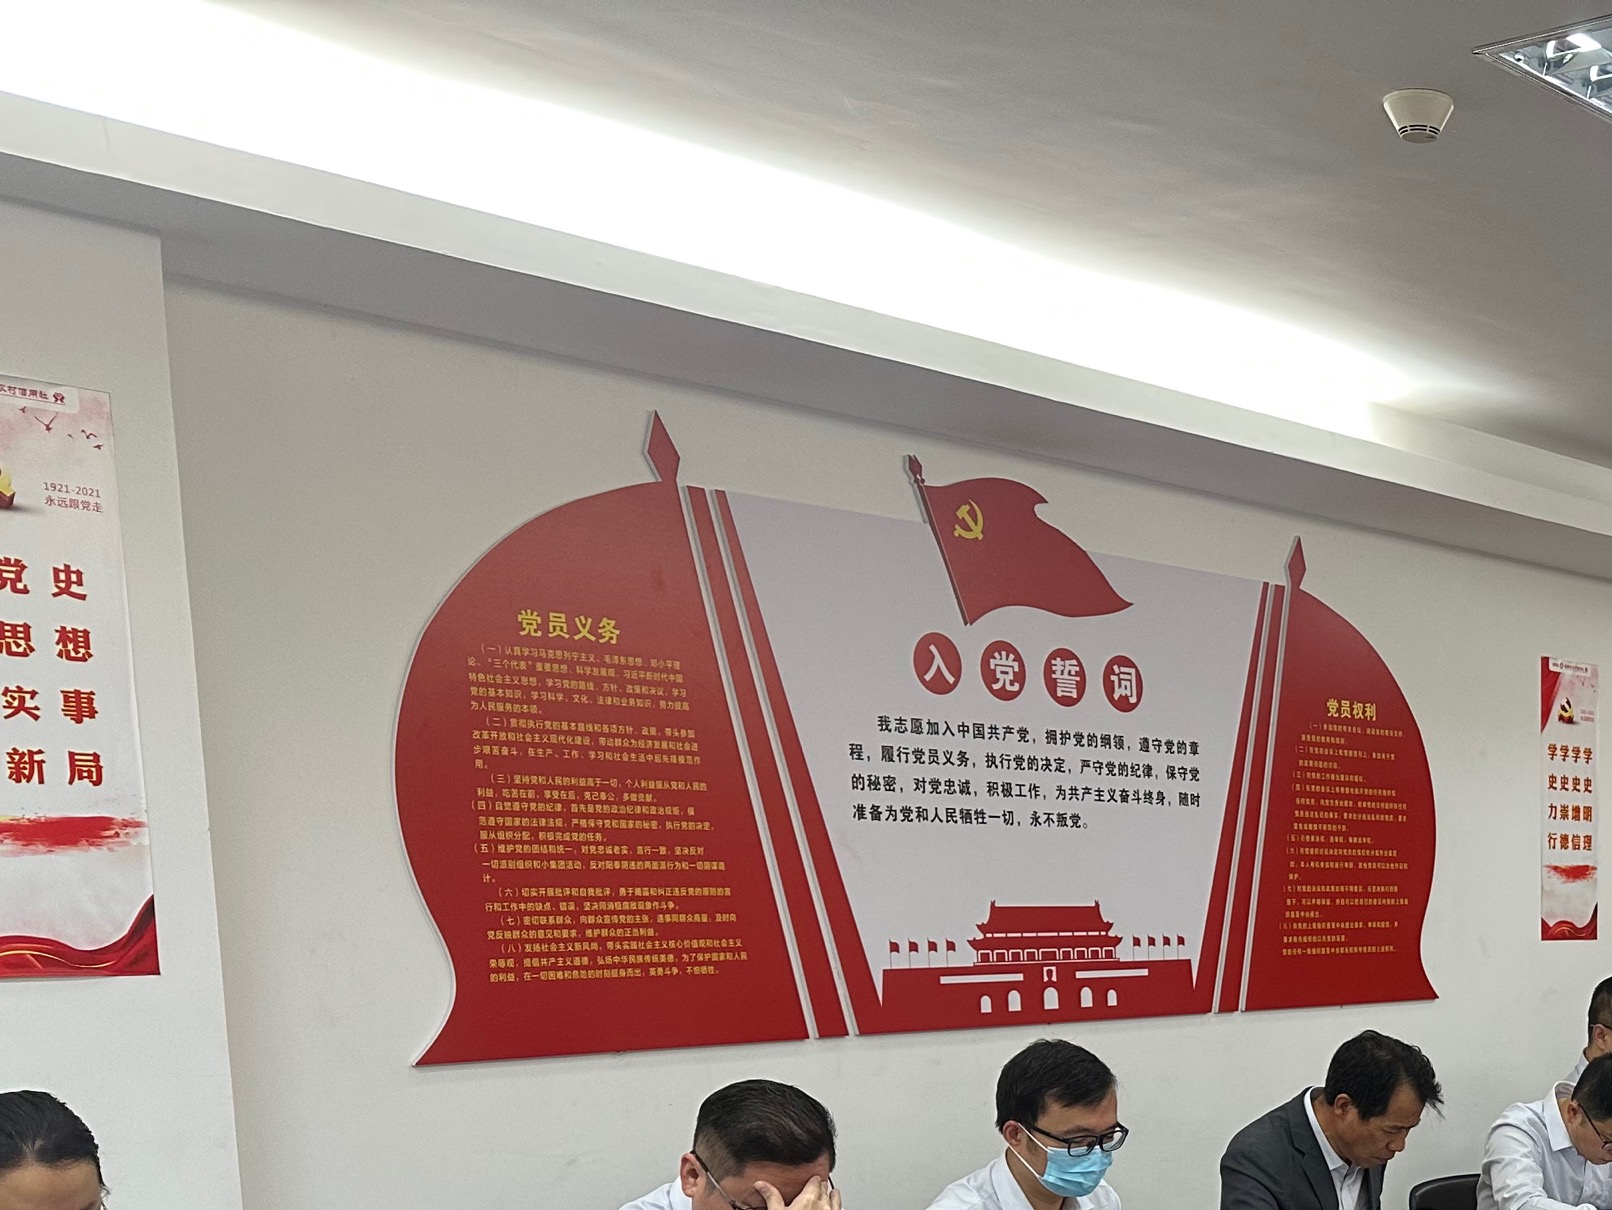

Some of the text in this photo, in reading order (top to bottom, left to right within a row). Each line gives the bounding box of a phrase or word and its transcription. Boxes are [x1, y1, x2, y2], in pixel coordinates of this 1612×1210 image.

[43, 482, 101, 498] 1921-2021
[45, 495, 103, 513] 永远跟党走
[0, 557, 88, 602] 党史
[0, 622, 94, 663] 思想
[517, 609, 621, 645] 党员义务
[924, 644, 1138, 705] 入党誓词
[1, 683, 98, 727] 实事
[1326, 698, 1377, 722] 党员权利
[7, 748, 103, 788] 新局
